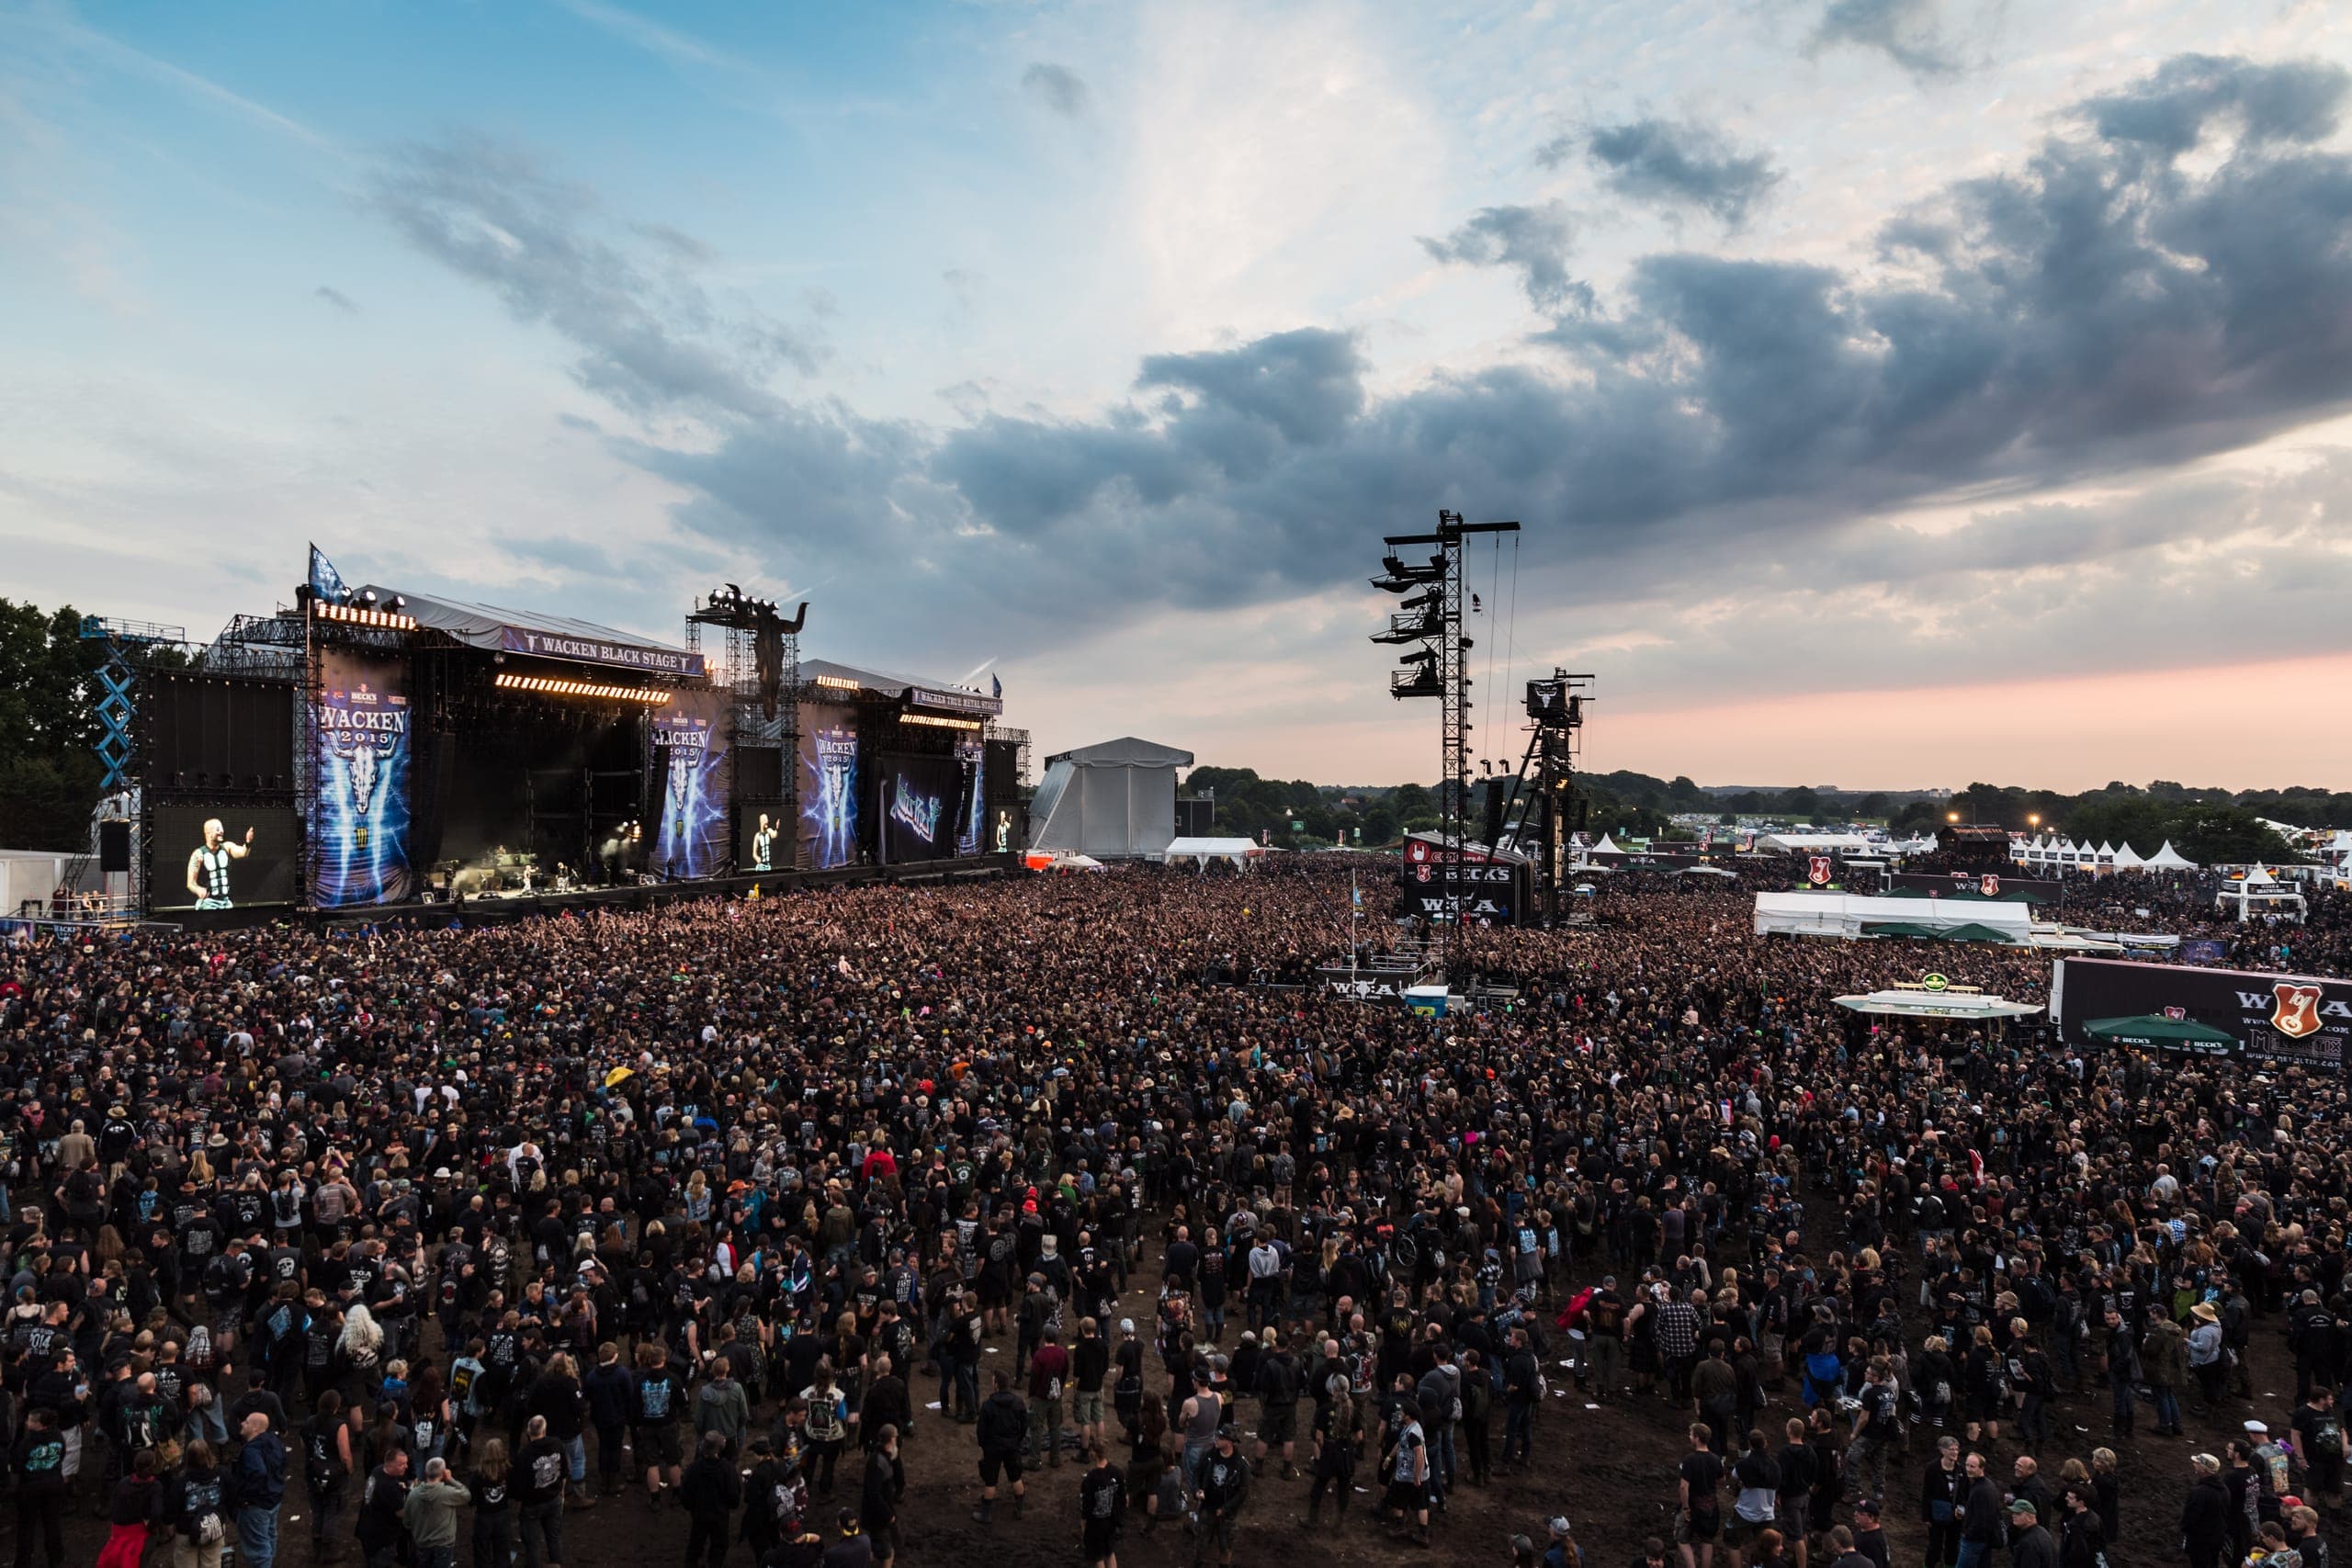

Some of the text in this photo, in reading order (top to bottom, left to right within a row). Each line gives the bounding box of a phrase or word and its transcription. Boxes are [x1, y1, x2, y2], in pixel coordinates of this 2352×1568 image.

[542, 637, 677, 669] WACKEN BLACK STAGE
[319, 705, 405, 733] WACKEN
[341, 731, 389, 744] 2015
[819, 739, 855, 756] WACKEN
